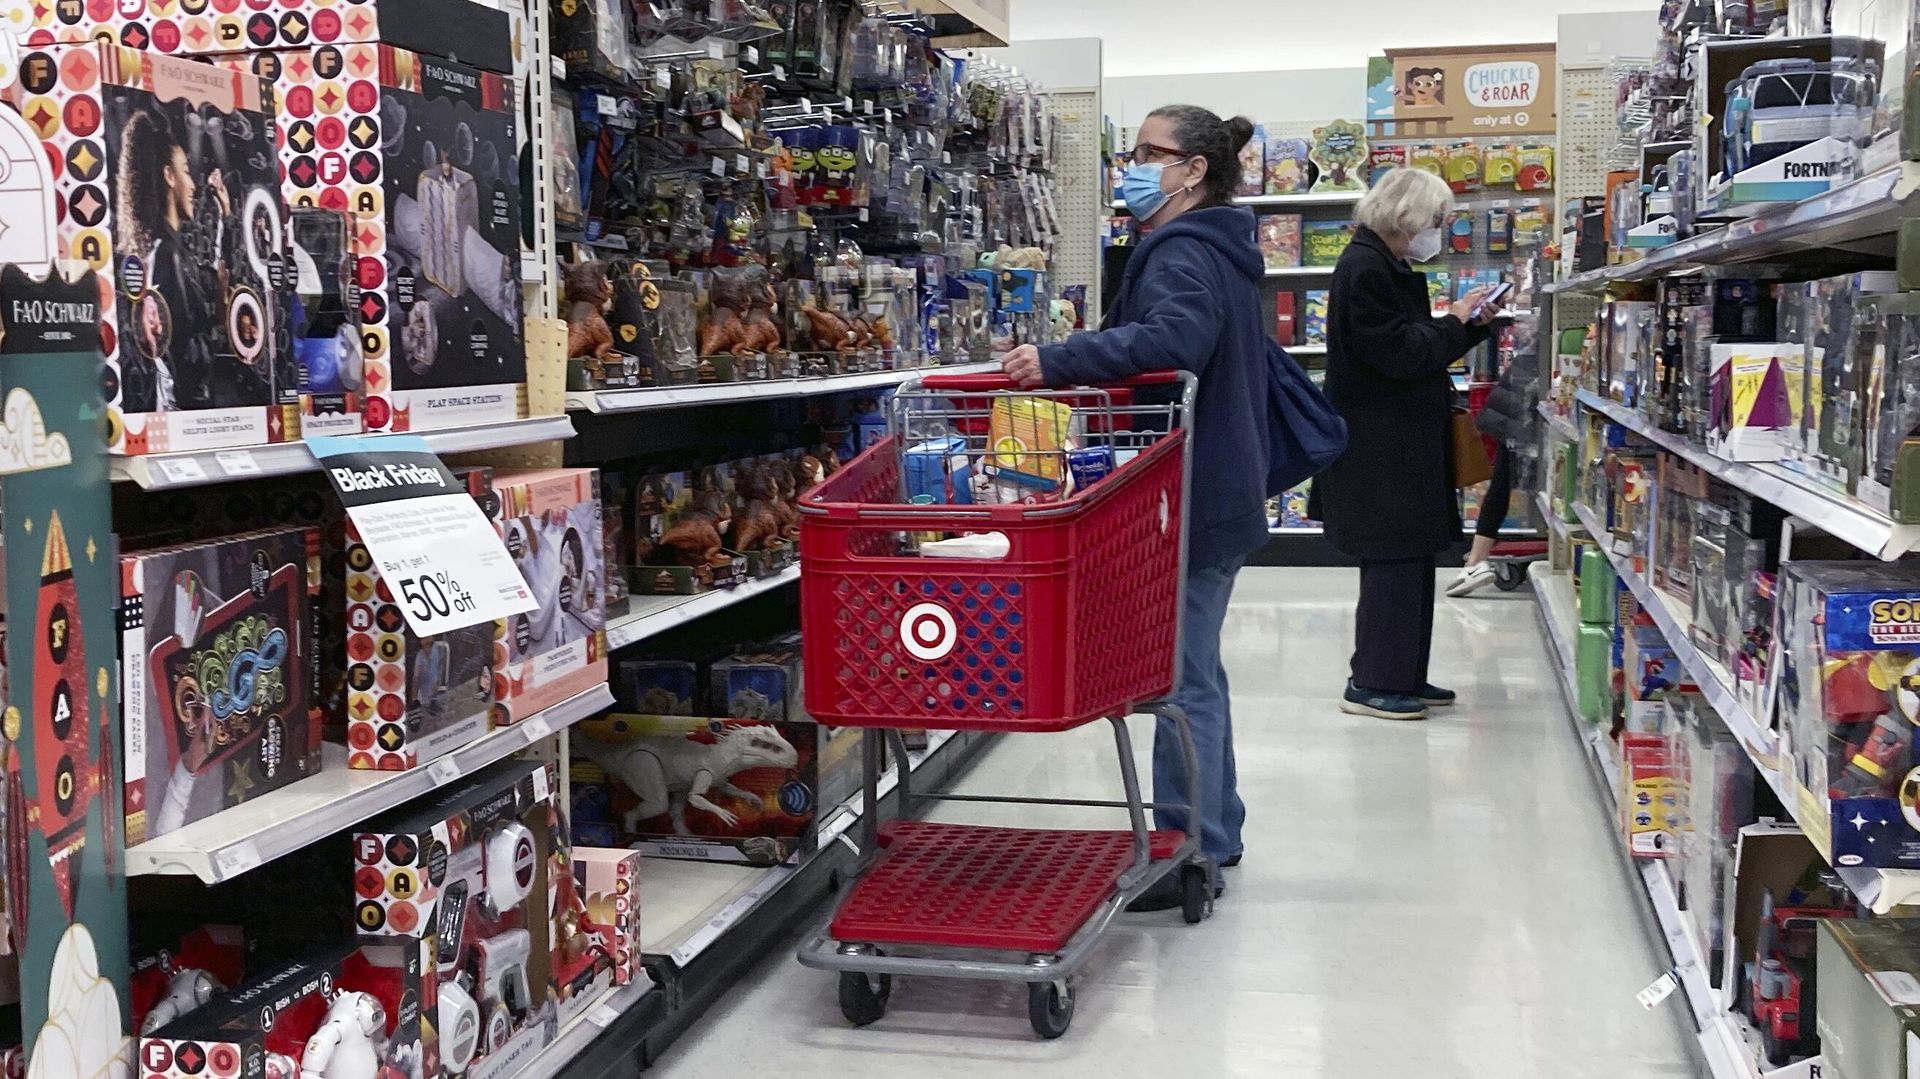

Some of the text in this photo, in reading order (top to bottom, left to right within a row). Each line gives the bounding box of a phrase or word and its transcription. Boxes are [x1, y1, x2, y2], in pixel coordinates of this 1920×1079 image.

[29, 59, 48, 87] F
[320, 52, 336, 74] F
[444, 68, 477, 88] SCHWARZ
[1469, 66, 1534, 93] CHUCKLE
[1493, 82, 1530, 101] ROAR
[71, 100, 94, 128] A
[1473, 113, 1512, 127] only at
[324, 158, 340, 180] F
[1784, 162, 1842, 179] FORTN
[358, 191, 374, 212] A
[45, 301, 95, 324] SCHWARZ
[427, 399, 447, 409] PLAY
[330, 463, 446, 492] Black Friday
[384, 561, 402, 572] Buy
[411, 557, 425, 568] get
[399, 570, 461, 621] 50%
[453, 592, 476, 612] off
[51, 618, 72, 801] F A O
[267, 718, 275, 777] GLOWING
[361, 840, 376, 860] F
[394, 873, 410, 893] A
[275, 996, 290, 1011] BISH
[302, 980, 319, 996] BOSH
[149, 1046, 165, 1068] F
